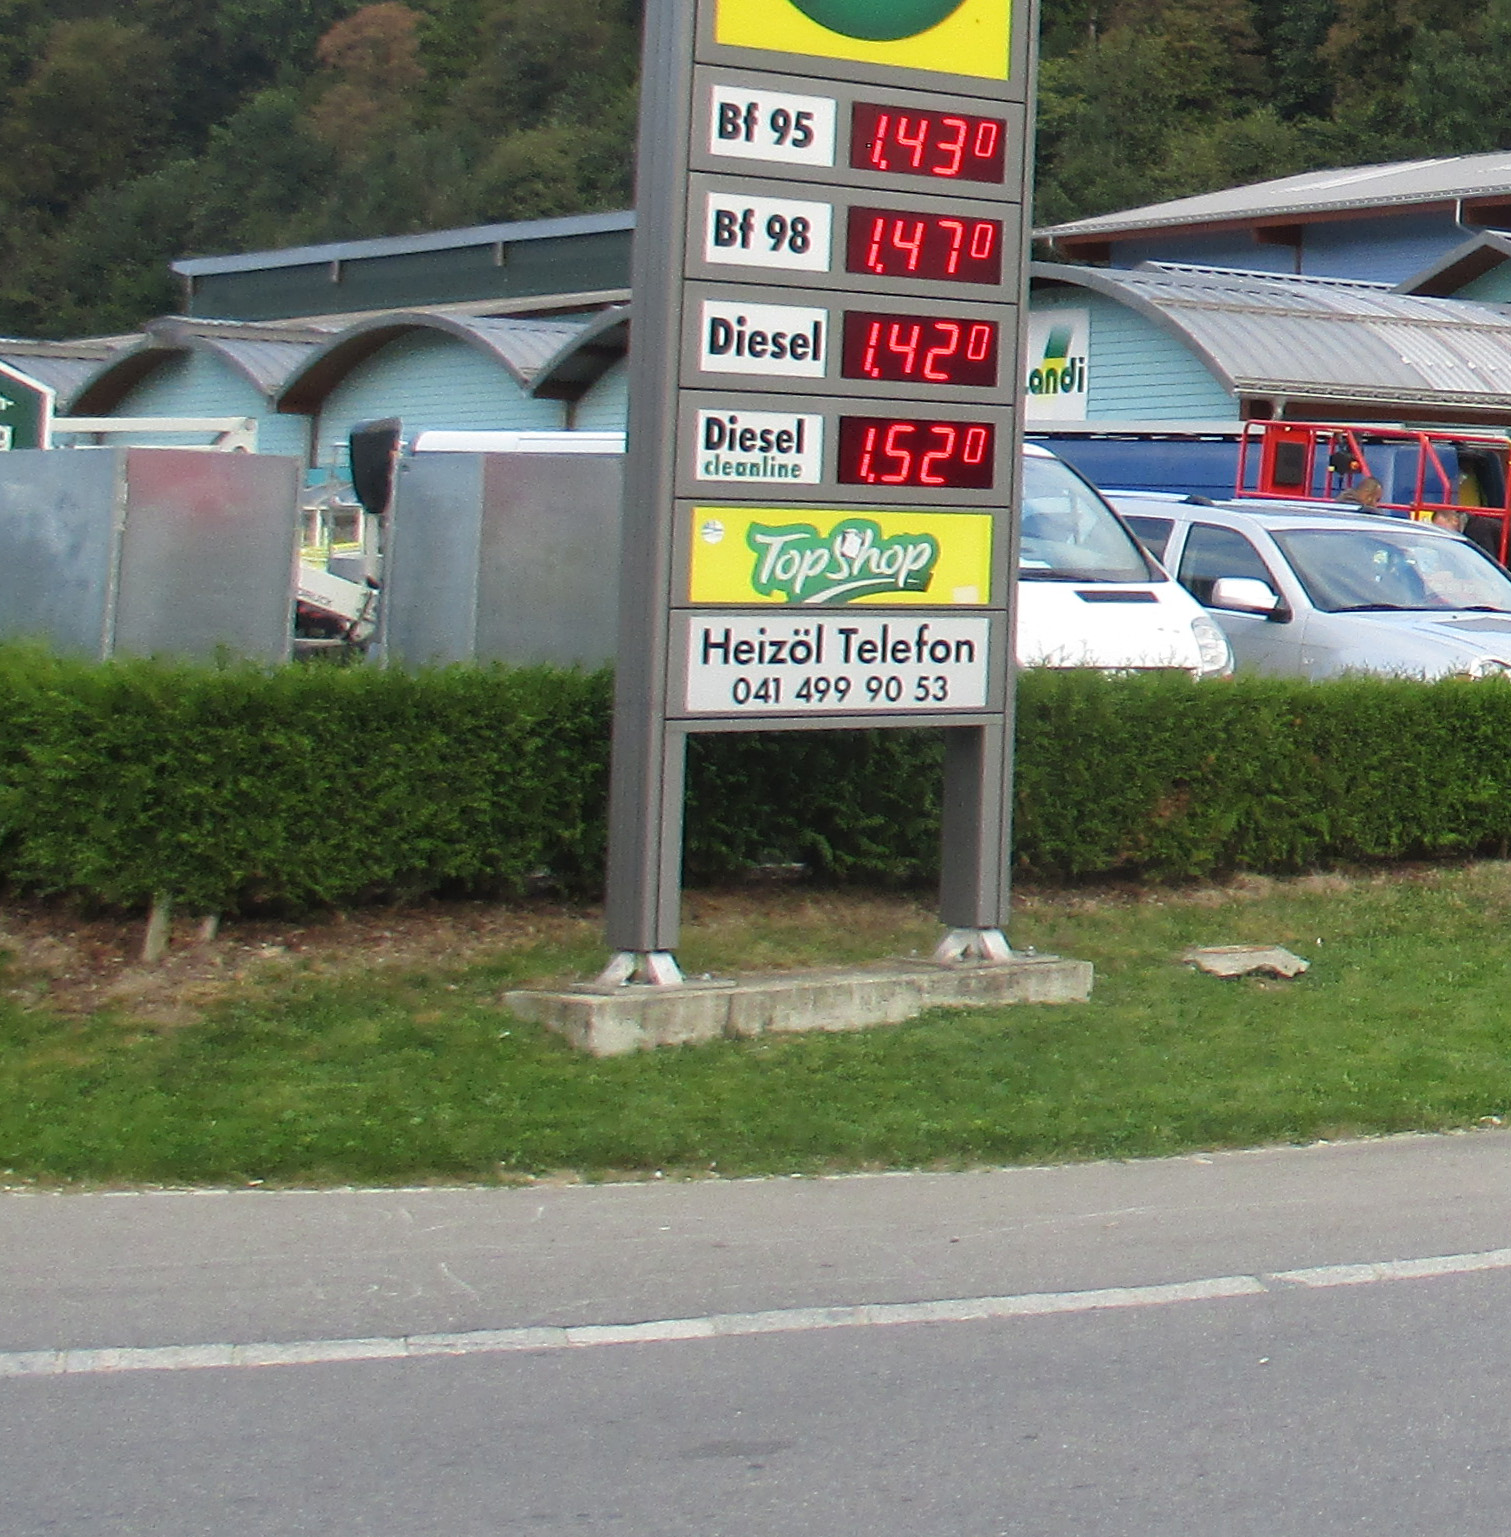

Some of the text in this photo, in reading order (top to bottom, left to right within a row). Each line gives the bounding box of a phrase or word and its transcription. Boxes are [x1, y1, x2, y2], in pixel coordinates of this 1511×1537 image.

[719, 102, 814, 149] Bf 95
[714, 208, 811, 254] Bf 98
[708, 315, 822, 362] Diesel
[1025, 357, 1085, 394] andi
[704, 415, 806, 454] Diesel
[704, 455, 801, 479] cleanline
[703, 624, 975, 665] Heizöl Telefon
[732, 675, 949, 705] 041 499 90 53
